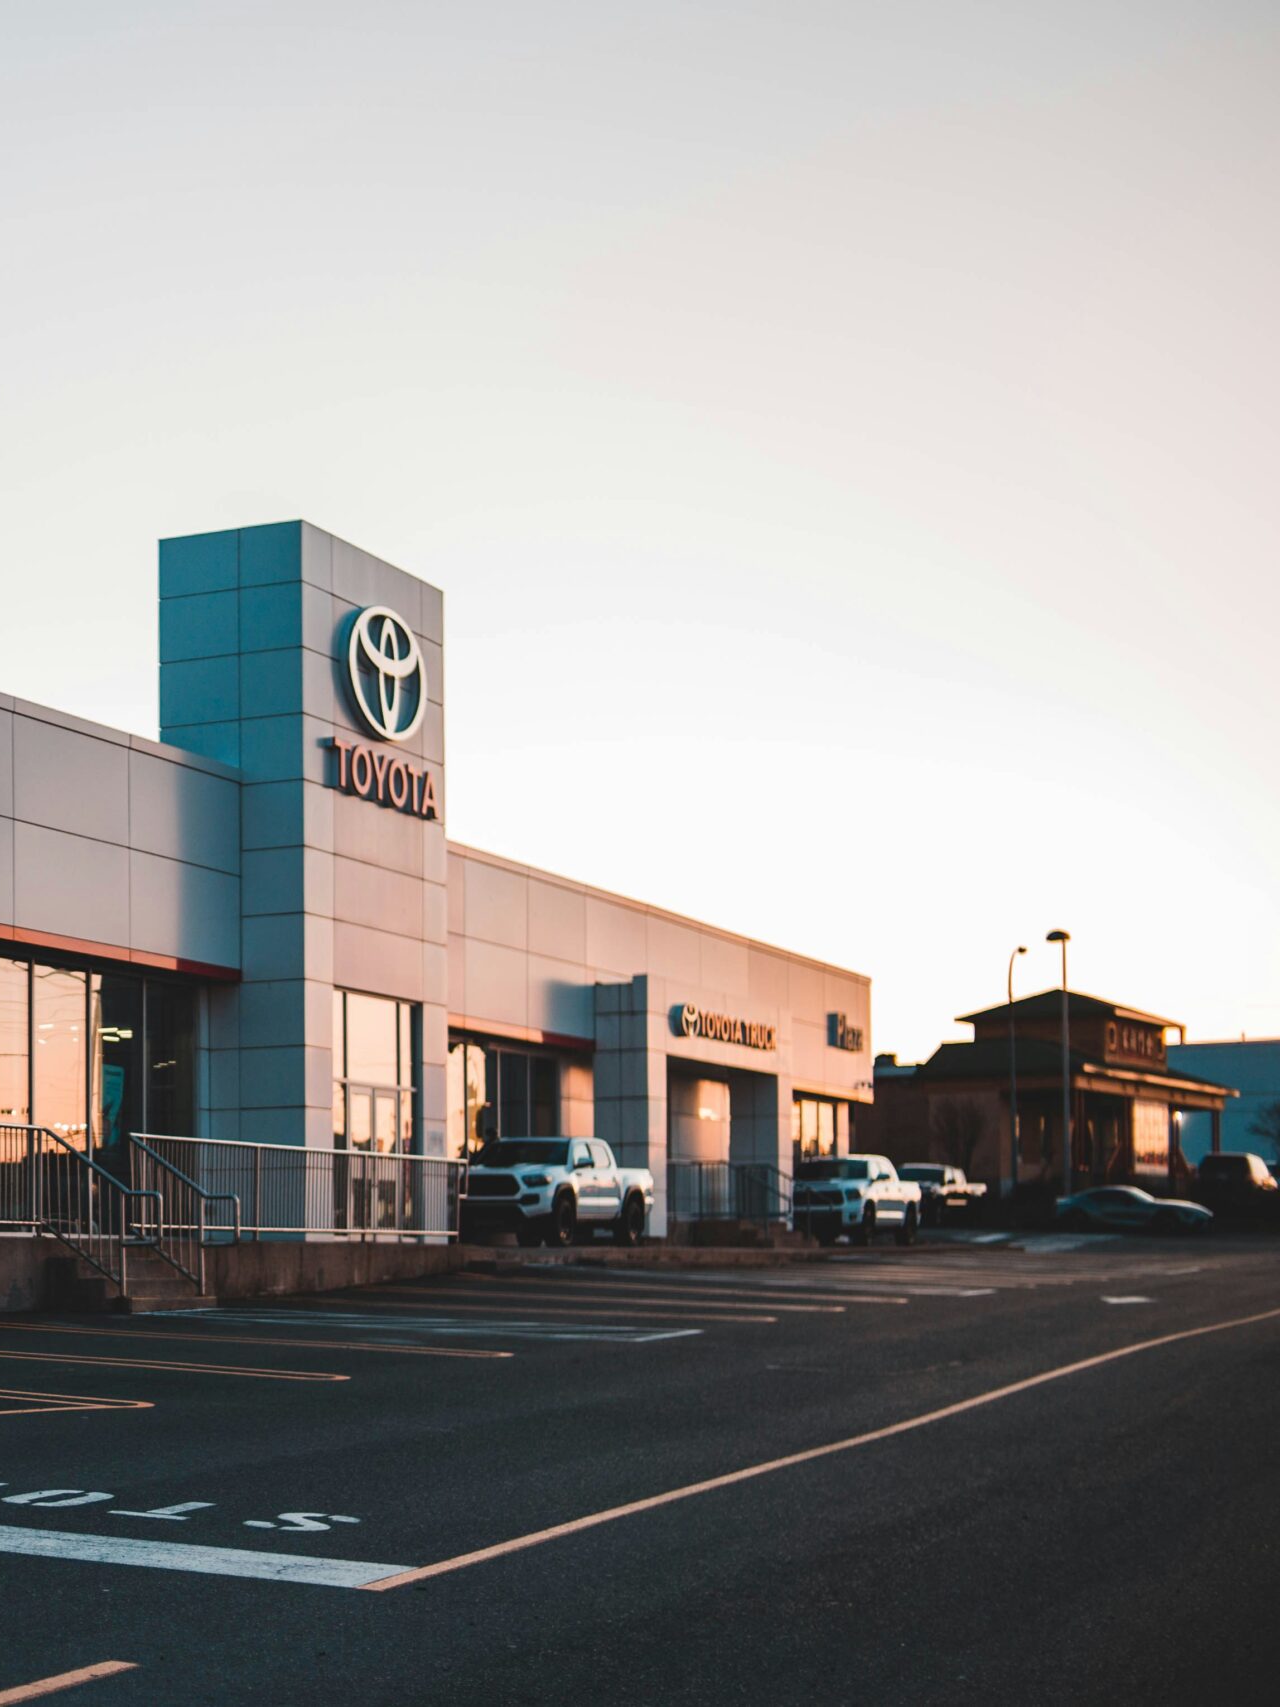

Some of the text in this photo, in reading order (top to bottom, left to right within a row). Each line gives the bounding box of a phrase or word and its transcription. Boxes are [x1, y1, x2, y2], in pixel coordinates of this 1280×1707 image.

[329, 736, 438, 820] TOYOTA
[699, 1009, 777, 1051] TOYOTA TRUCK
